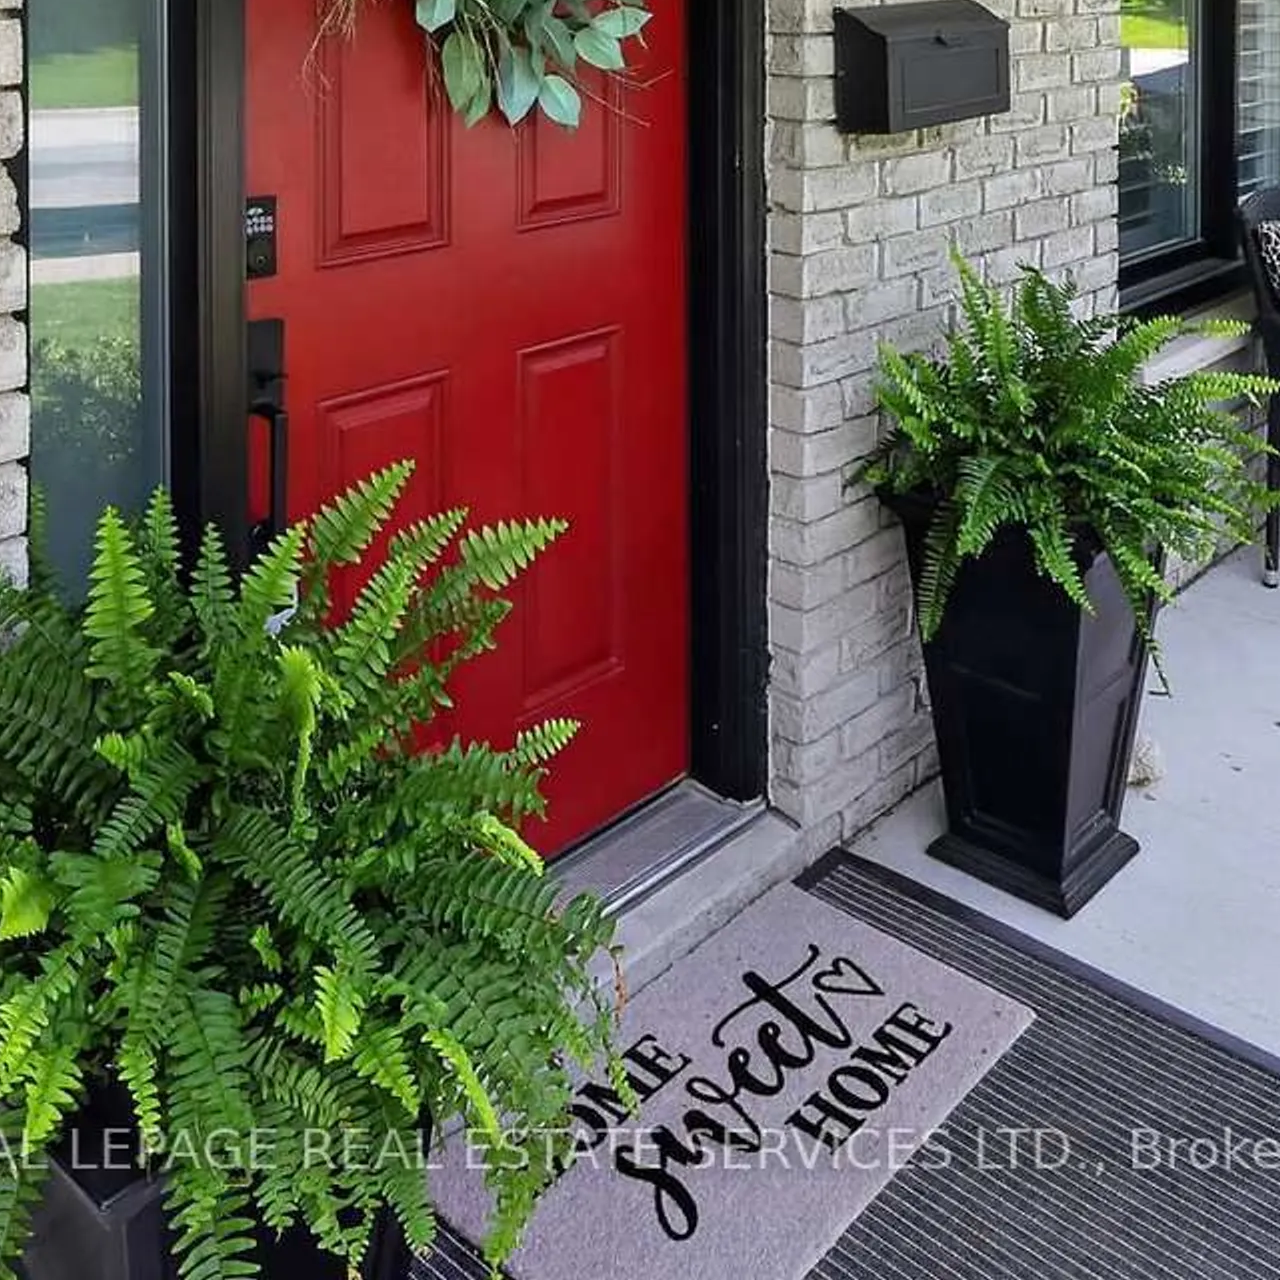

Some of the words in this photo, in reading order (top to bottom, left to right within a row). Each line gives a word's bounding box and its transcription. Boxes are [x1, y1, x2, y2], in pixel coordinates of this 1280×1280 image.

[533, 1034, 693, 1198] OME
[616, 944, 852, 1241] sweet
[785, 1001, 953, 1155] HOME
